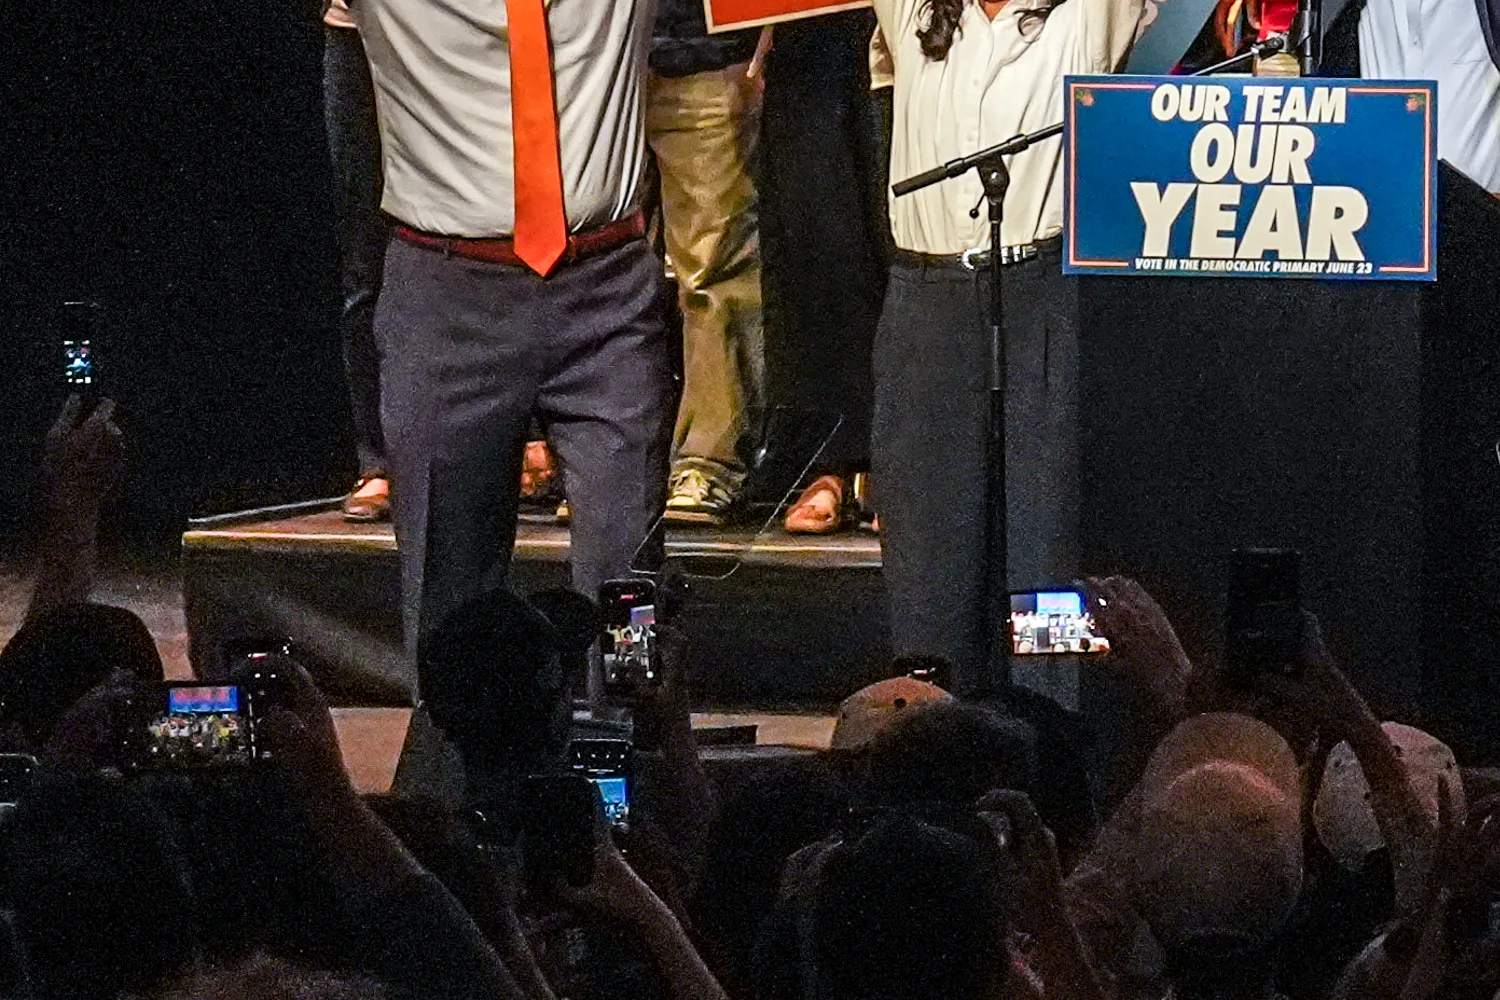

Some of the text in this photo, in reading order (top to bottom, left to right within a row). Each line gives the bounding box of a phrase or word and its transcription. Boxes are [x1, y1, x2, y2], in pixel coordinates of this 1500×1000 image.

[1151, 83, 1347, 124] OUR TEAM
[1190, 122, 1315, 184] OUR
[1130, 181, 1369, 262] YEAR
[1135, 258, 1374, 274] VOTE IN THE DEMOCRATIC PRIMARY JUNE 23
